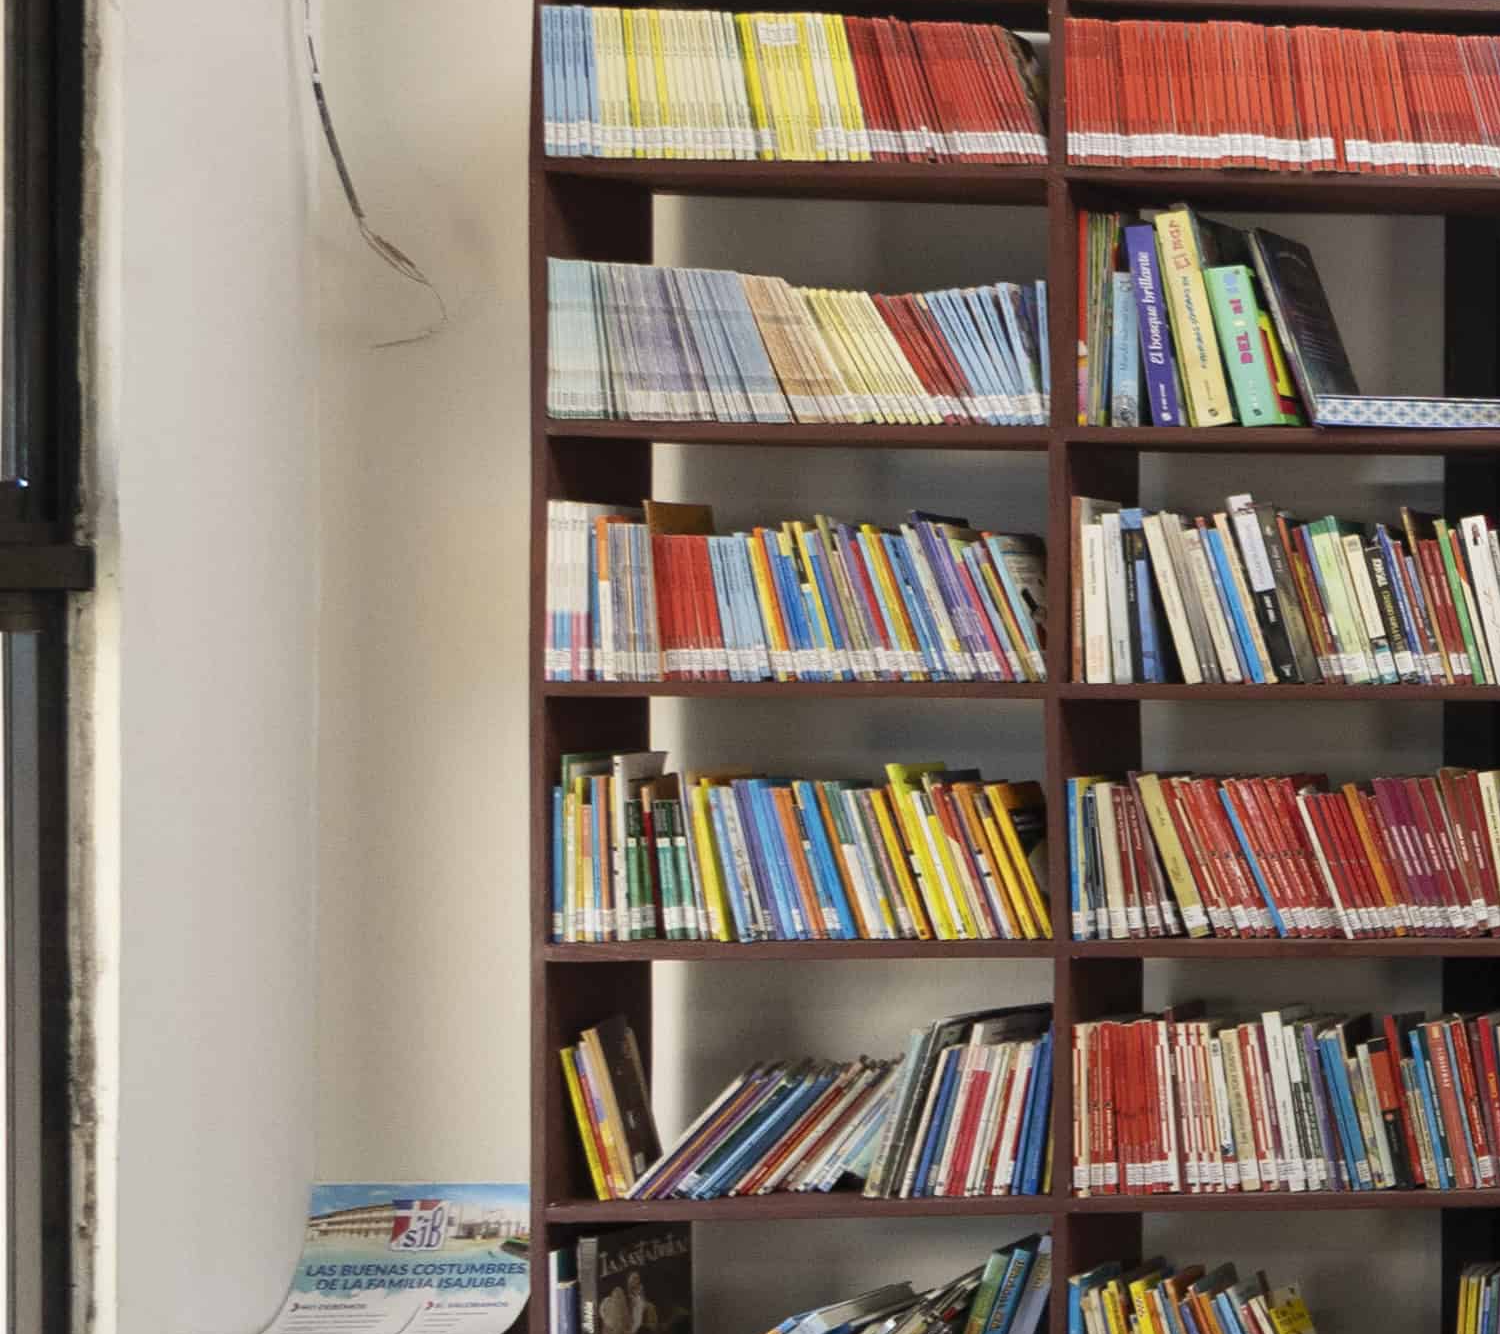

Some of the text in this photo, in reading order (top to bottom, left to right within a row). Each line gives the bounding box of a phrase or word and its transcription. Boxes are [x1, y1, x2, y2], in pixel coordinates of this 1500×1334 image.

[1136, 252, 1165, 365] El bosque brillante
[1235, 332, 1253, 364] DEL
[305, 1263, 528, 1278] LAS BUENAS COSTUMBRES
[315, 1278, 339, 1291] DE
[341, 1278, 363, 1290] LA
[364, 1278, 433, 1290] FAMILIA
